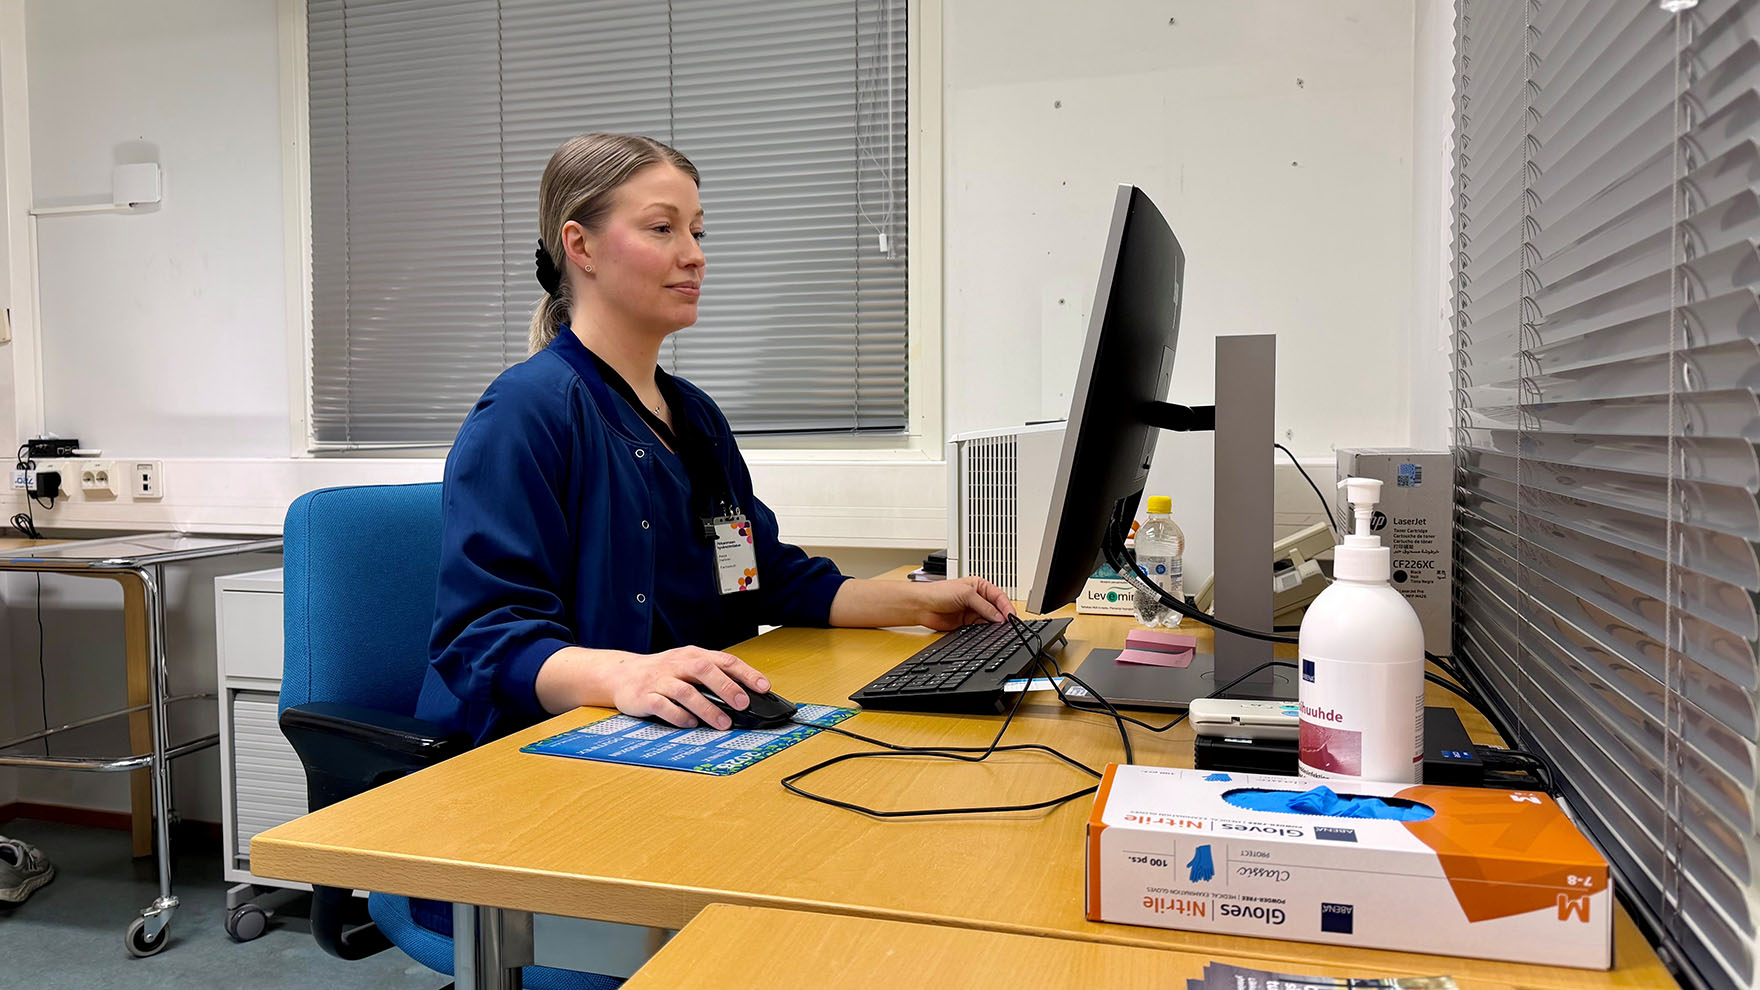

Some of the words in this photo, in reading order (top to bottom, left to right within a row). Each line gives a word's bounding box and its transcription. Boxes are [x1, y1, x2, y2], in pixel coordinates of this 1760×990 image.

[1393, 517, 1427, 525] LaserJet
[1393, 559, 1435, 569] CF226XC
[1509, 794, 1542, 805] M
[1124, 815, 1202, 829] Nitrile
[1222, 823, 1304, 837] Gloves
[1240, 850, 1270, 859] PROTECT
[1128, 856, 1147, 864] pcs.
[1150, 858, 1168, 867] 100
[1237, 866, 1290, 882] Classic
[1567, 874, 1592, 887] 7-8
[1169, 889, 1209, 898] EXAMINATION
[1241, 895, 1286, 904] POWDER-FREE
[1143, 896, 1206, 918] Nitrile
[1322, 904, 1353, 914] ABENA
[1557, 893, 1590, 923] M
[1220, 904, 1286, 925] Gloves
